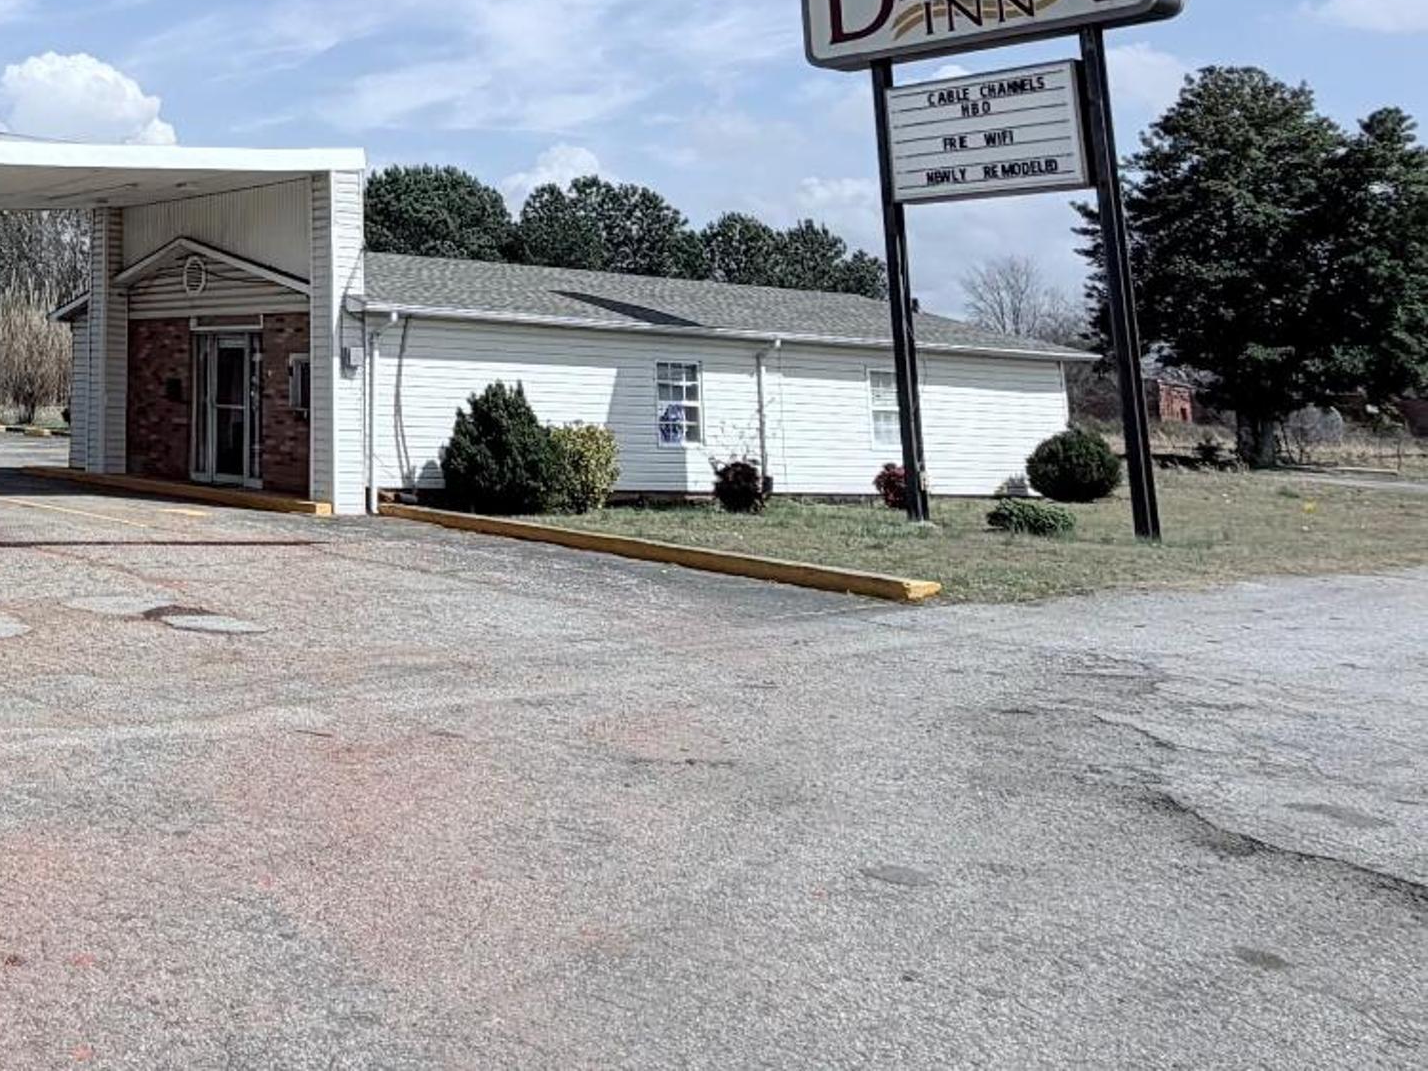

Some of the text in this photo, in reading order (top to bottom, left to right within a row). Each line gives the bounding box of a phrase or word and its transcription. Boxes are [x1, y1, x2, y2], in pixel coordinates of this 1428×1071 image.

[927, 76, 1045, 107] CABLE CHANNELS
[961, 101, 991, 117] HBO
[984, 130, 1014, 146] WIFI
[926, 159, 1058, 186] NEWLY REMODELED
